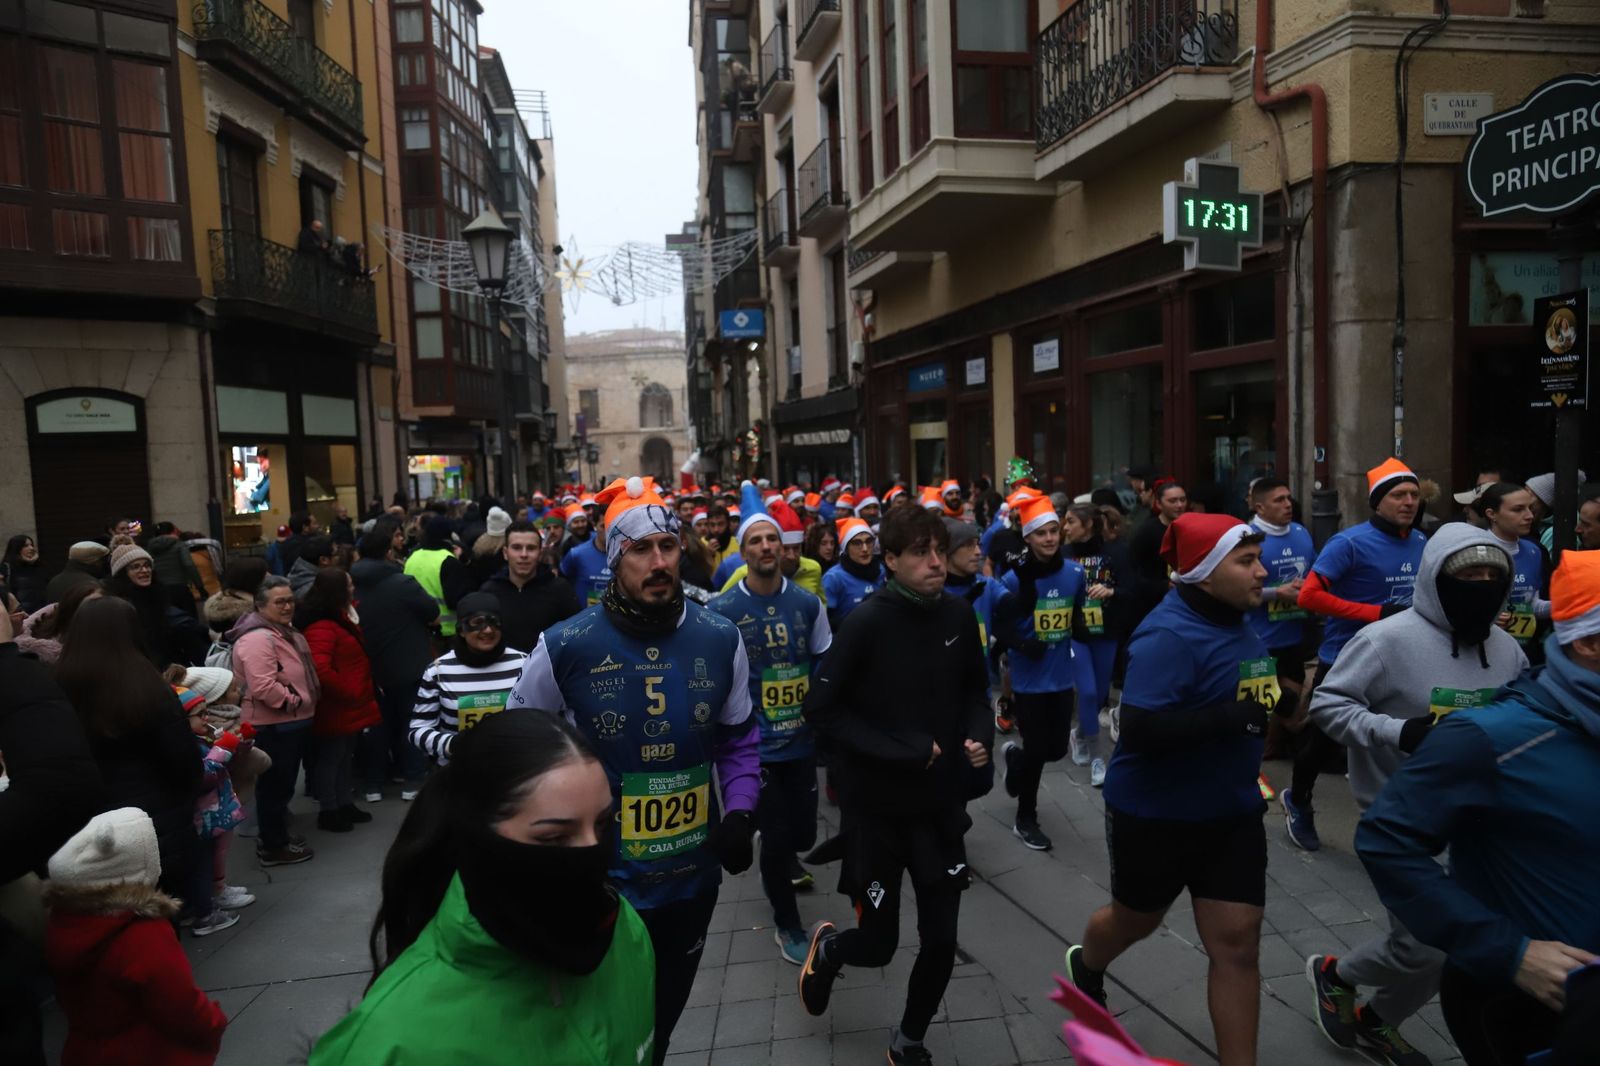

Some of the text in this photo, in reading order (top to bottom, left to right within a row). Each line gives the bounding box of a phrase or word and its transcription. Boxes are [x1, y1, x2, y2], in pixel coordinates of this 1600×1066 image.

[1449, 99, 1478, 108] CALLE
[1454, 110, 1466, 118] DE
[1429, 121, 1475, 130] QUEBRANTAHU
[1184, 199, 1248, 232] 17:31
[1513, 263, 1531, 277] Un
[1541, 280, 1558, 294] de
[1282, 547, 1293, 557] 46
[1401, 562, 1412, 573] 46
[1514, 573, 1526, 583] 46
[1046, 588, 1059, 598] 46
[1039, 612, 1070, 631] 621
[764, 622, 788, 648] 19
[589, 663, 624, 674] MERCURY
[635, 663, 673, 671] MORALEJO
[590, 676, 627, 689] ANGEL
[644, 676, 666, 716] 5
[766, 682, 806, 707] 956
[641, 742, 676, 762] gaza
[648, 779, 691, 791] CAJA RURAL
[629, 791, 698, 833] 1029
[648, 831, 703, 854] CAJA RURAL
